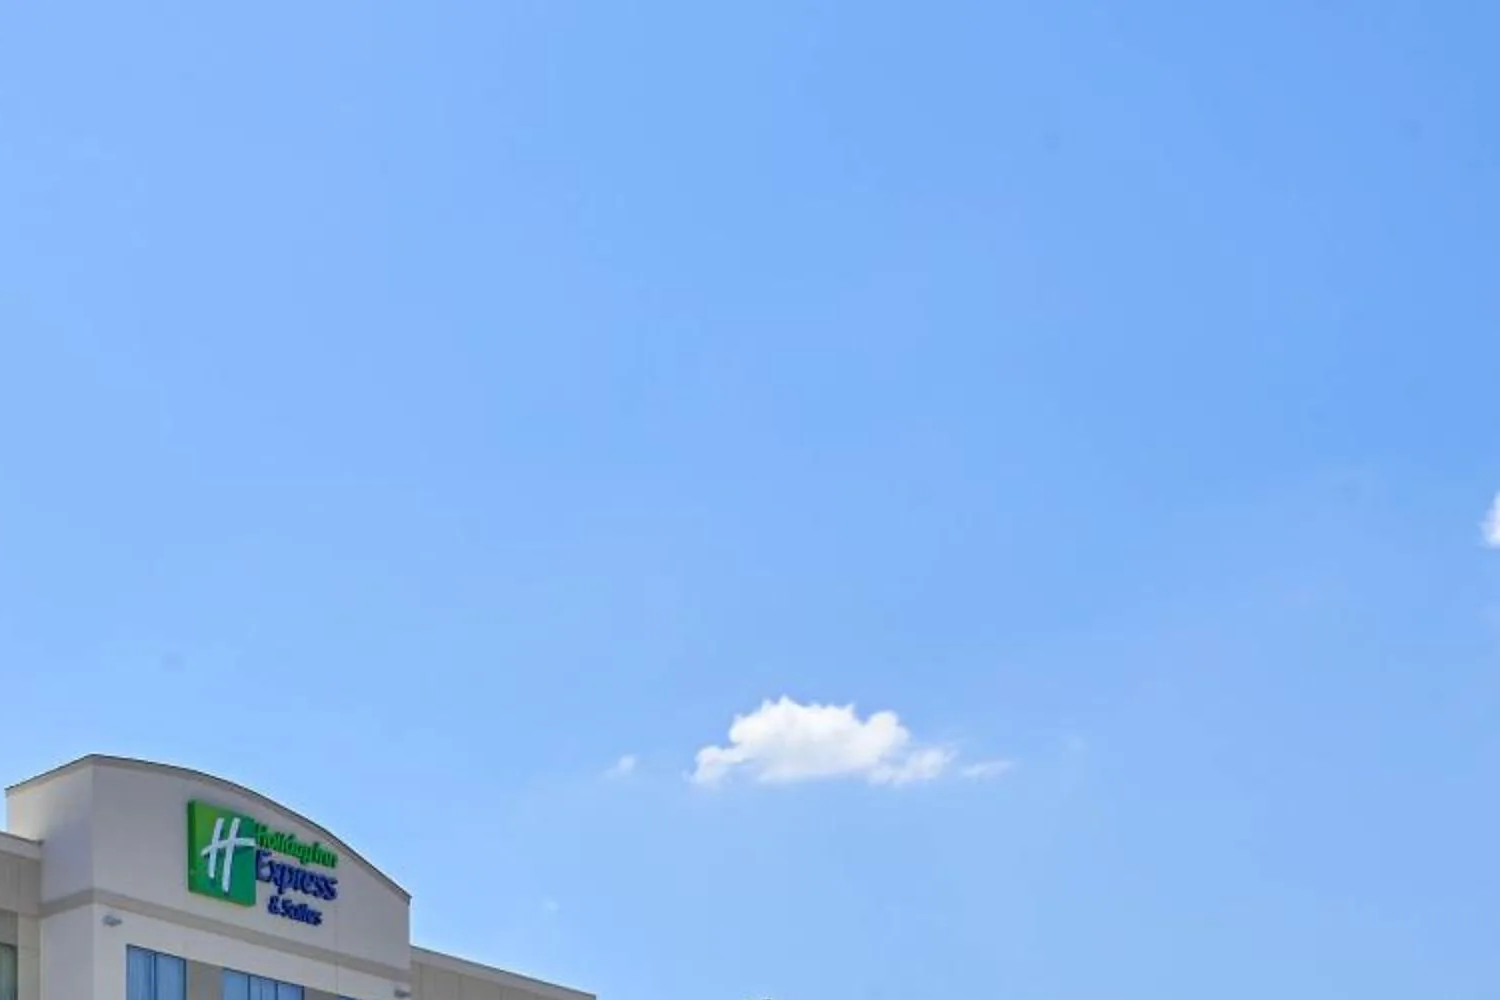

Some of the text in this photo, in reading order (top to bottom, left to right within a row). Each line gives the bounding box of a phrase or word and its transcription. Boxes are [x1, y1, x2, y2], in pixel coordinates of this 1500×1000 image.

[255, 850, 338, 900] Express
[268, 895, 323, 926] & Suites
